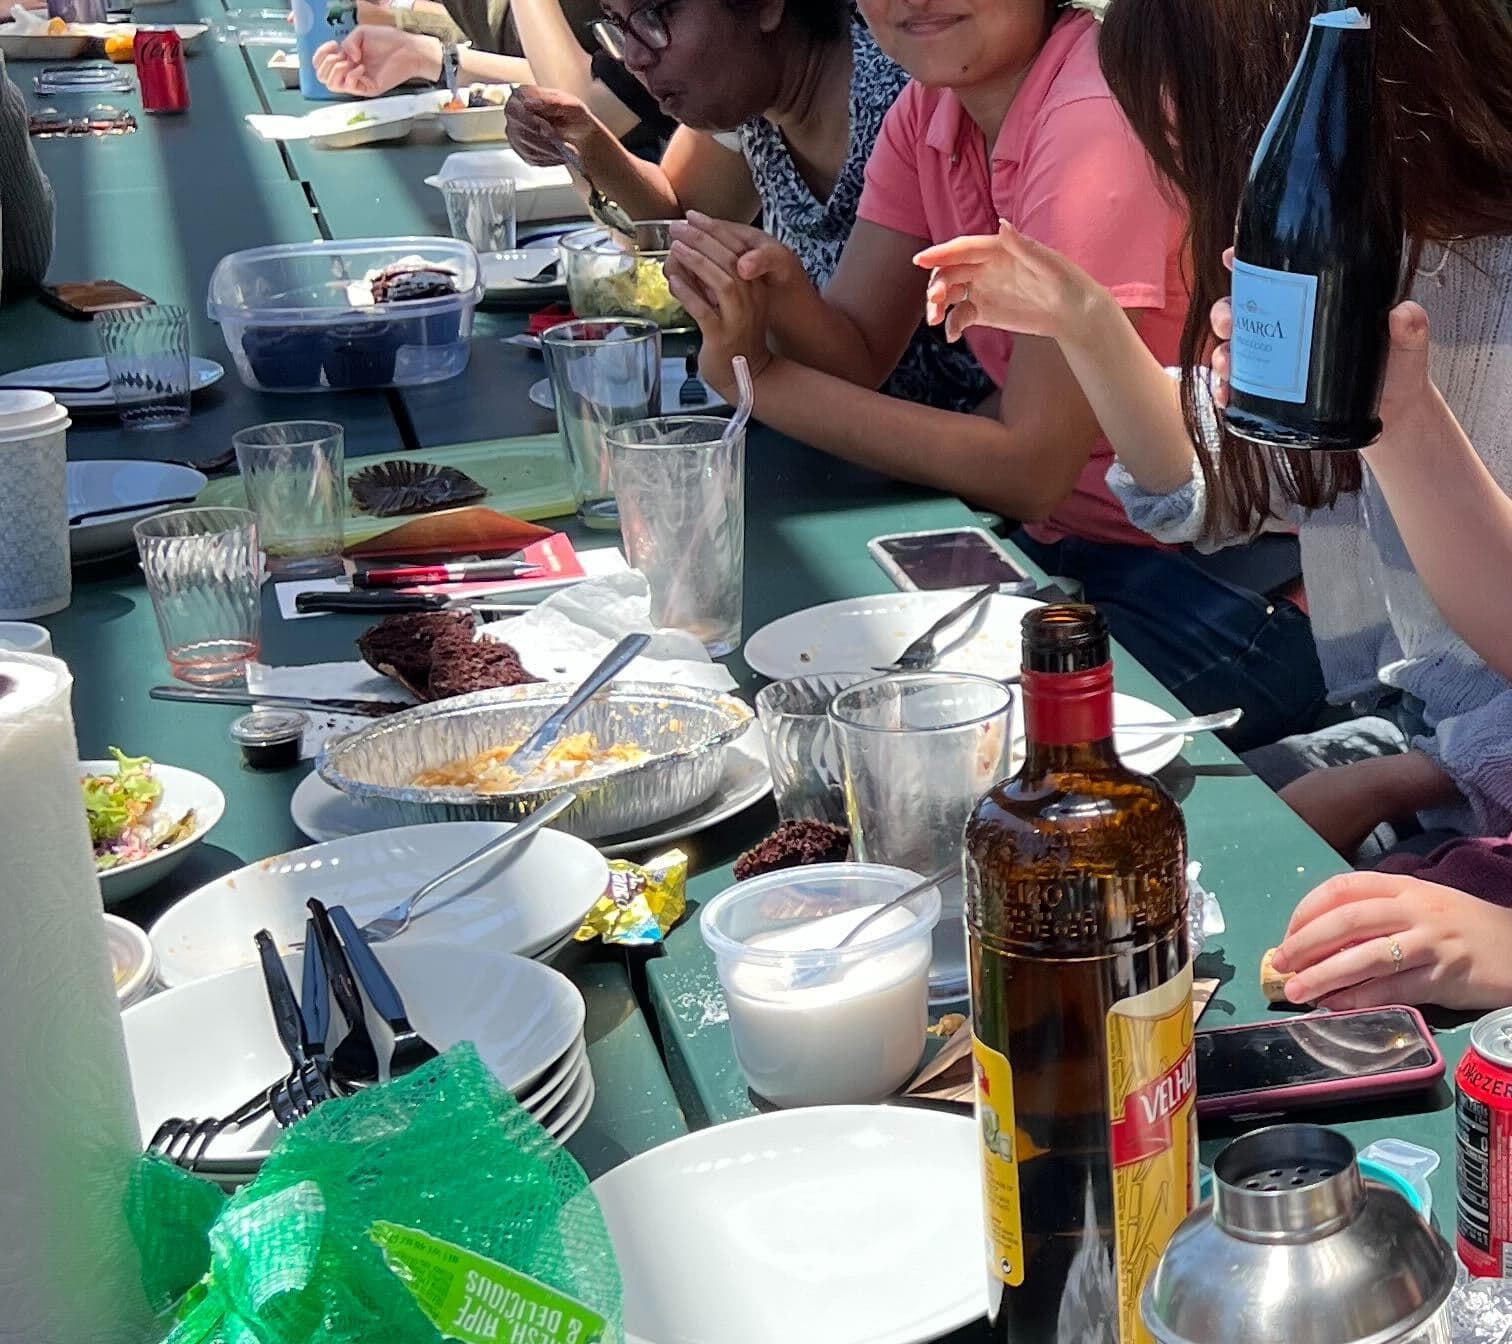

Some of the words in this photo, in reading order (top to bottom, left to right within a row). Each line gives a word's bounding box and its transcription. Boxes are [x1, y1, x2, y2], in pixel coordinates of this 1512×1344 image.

[1236, 317, 1284, 339] AMARCA
[1140, 1054, 1193, 1125] VELHO
[453, 1296, 500, 1339] RIPE
[465, 1270, 563, 1334] DELICIOUS
